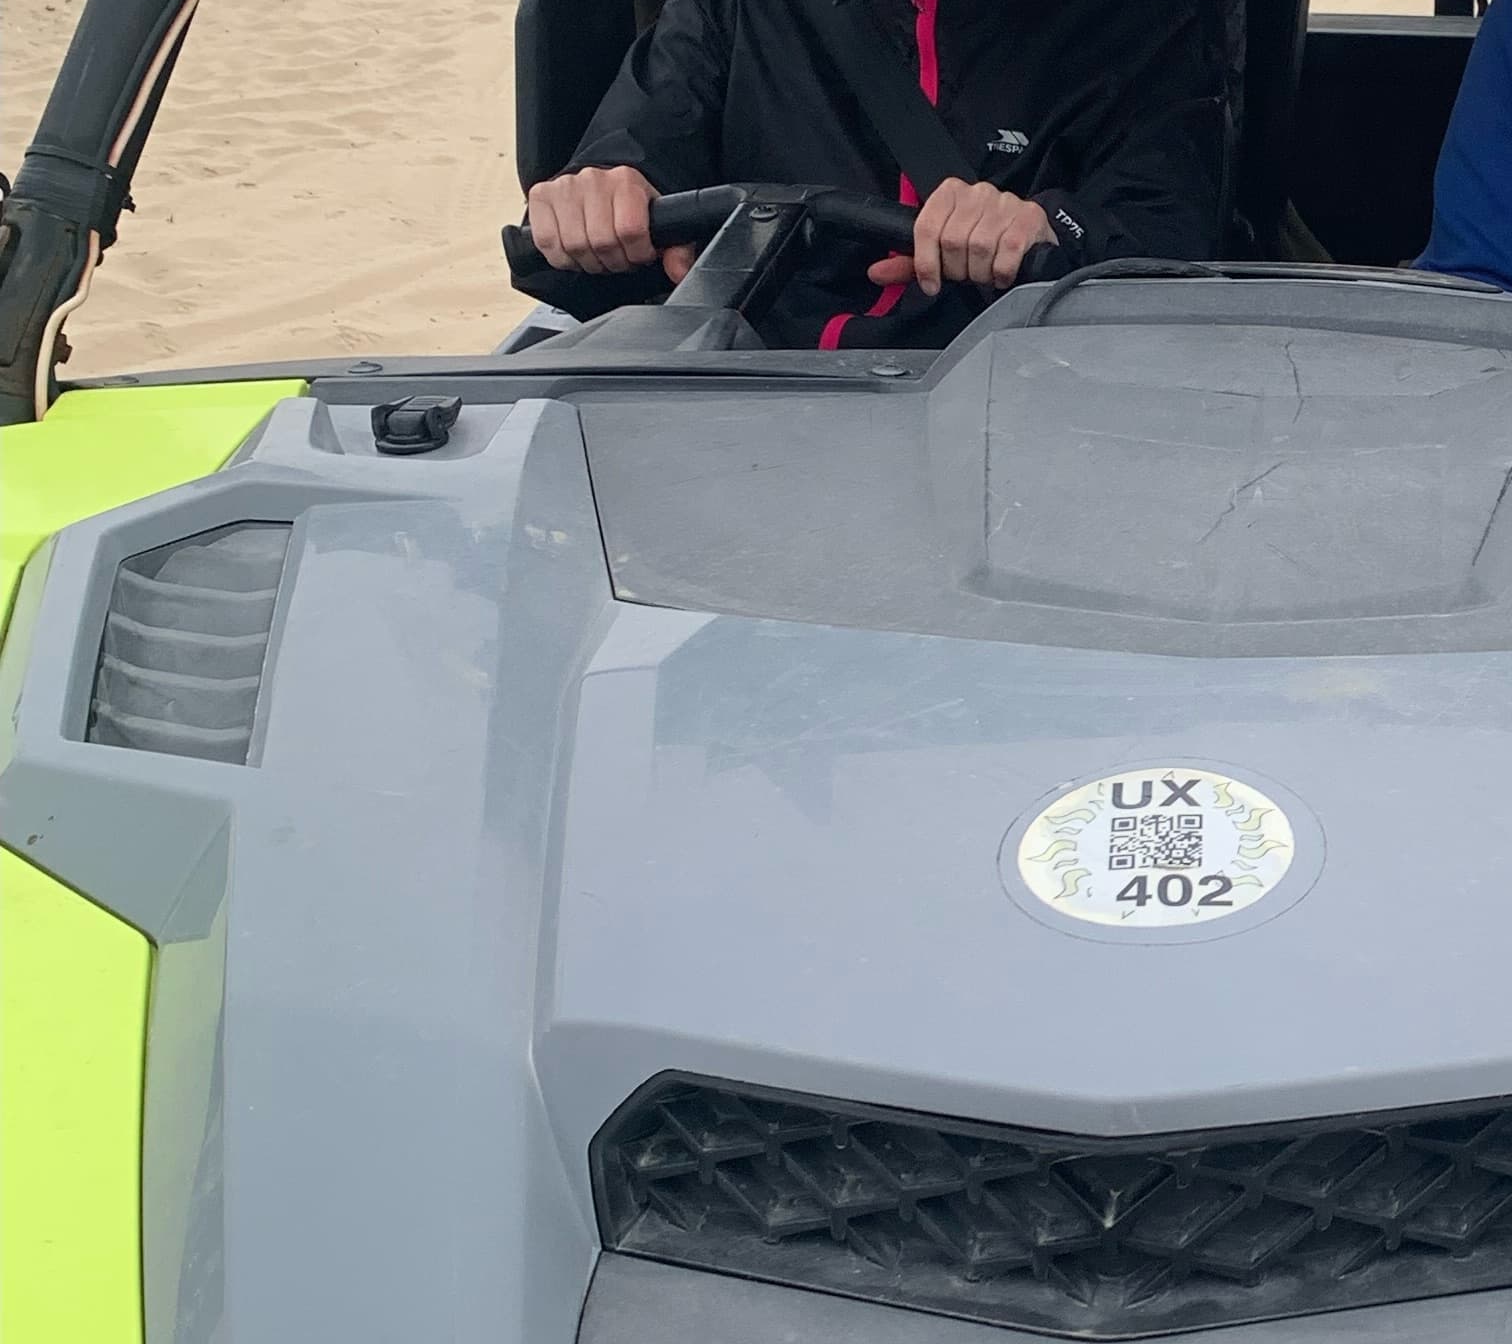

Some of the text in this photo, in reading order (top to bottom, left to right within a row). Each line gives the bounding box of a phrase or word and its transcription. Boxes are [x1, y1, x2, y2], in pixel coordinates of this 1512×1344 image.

[1055, 208, 1085, 239] TP75
[1111, 778, 1202, 811] UX
[1115, 873, 1234, 908] 402
